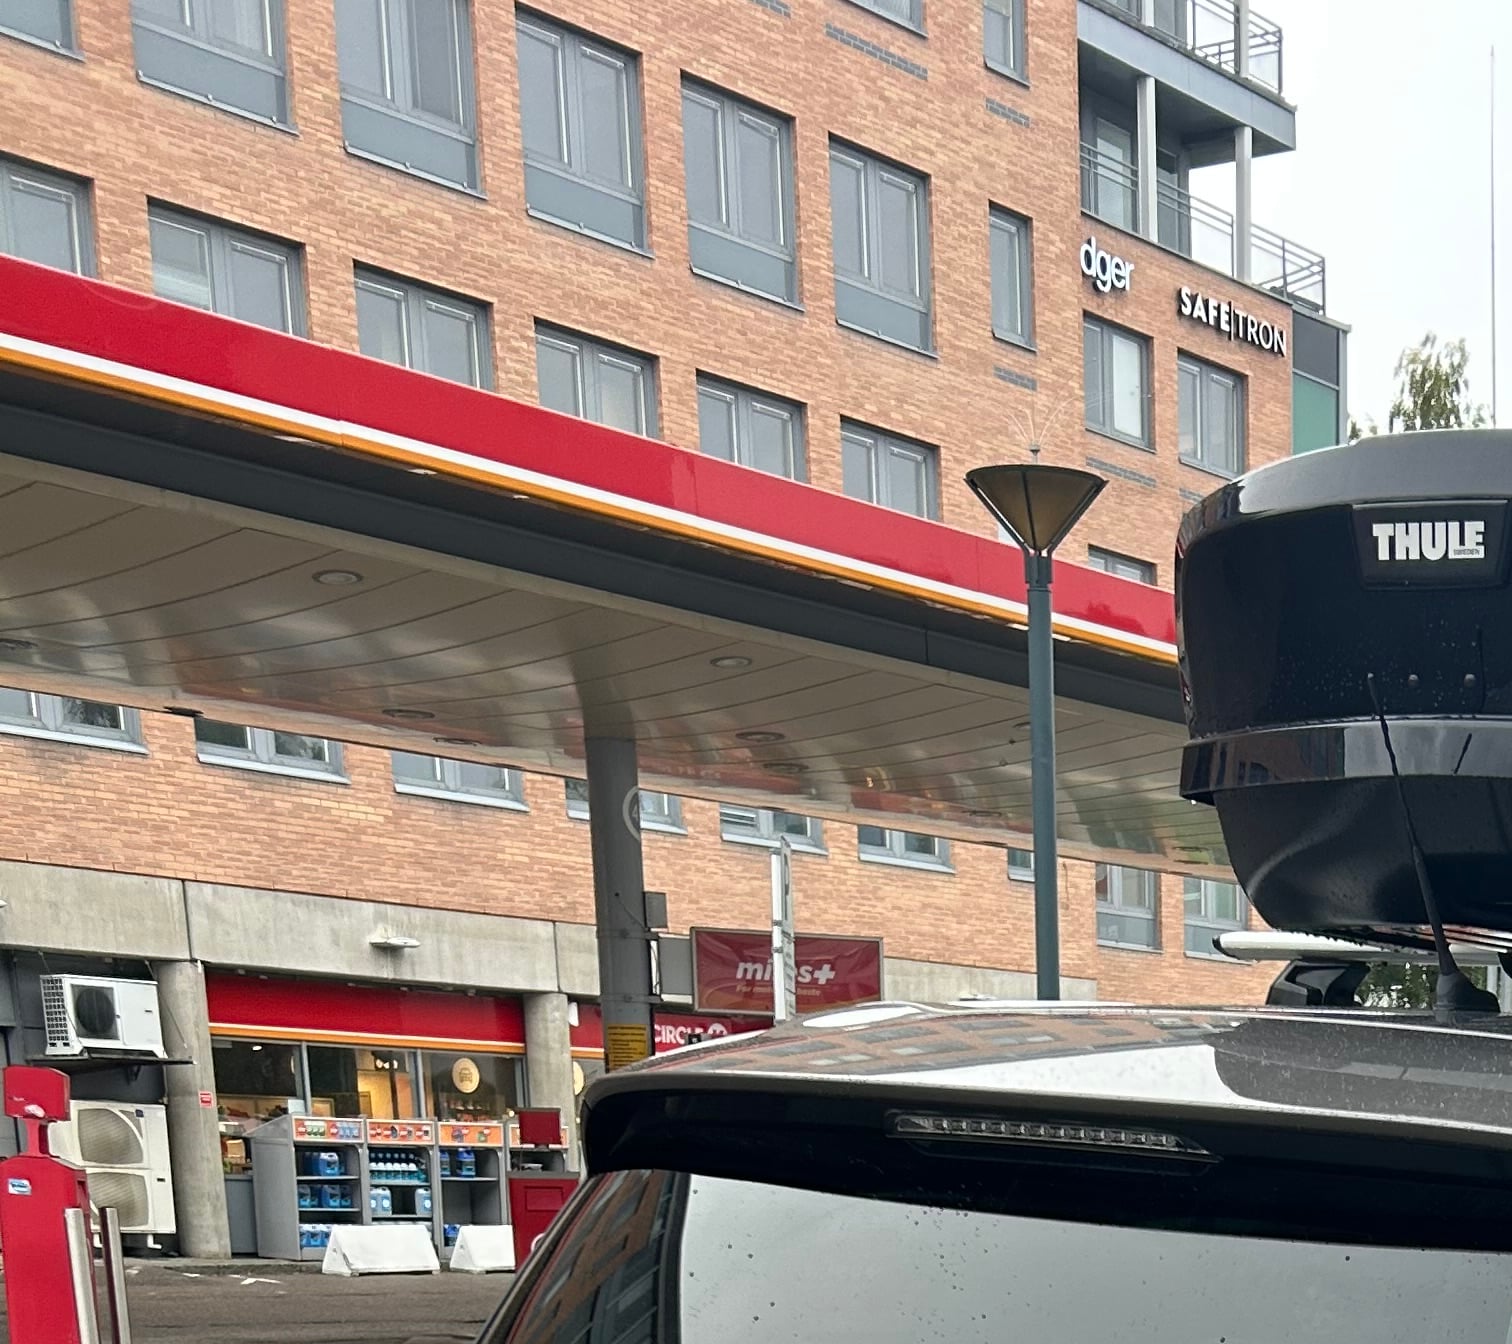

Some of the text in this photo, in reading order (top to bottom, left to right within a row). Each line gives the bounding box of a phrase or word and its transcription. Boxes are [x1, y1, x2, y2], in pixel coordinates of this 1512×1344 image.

[1080, 236, 1134, 293] dger
[1372, 520, 1485, 561] THULE
[736, 957, 836, 985] mis+
